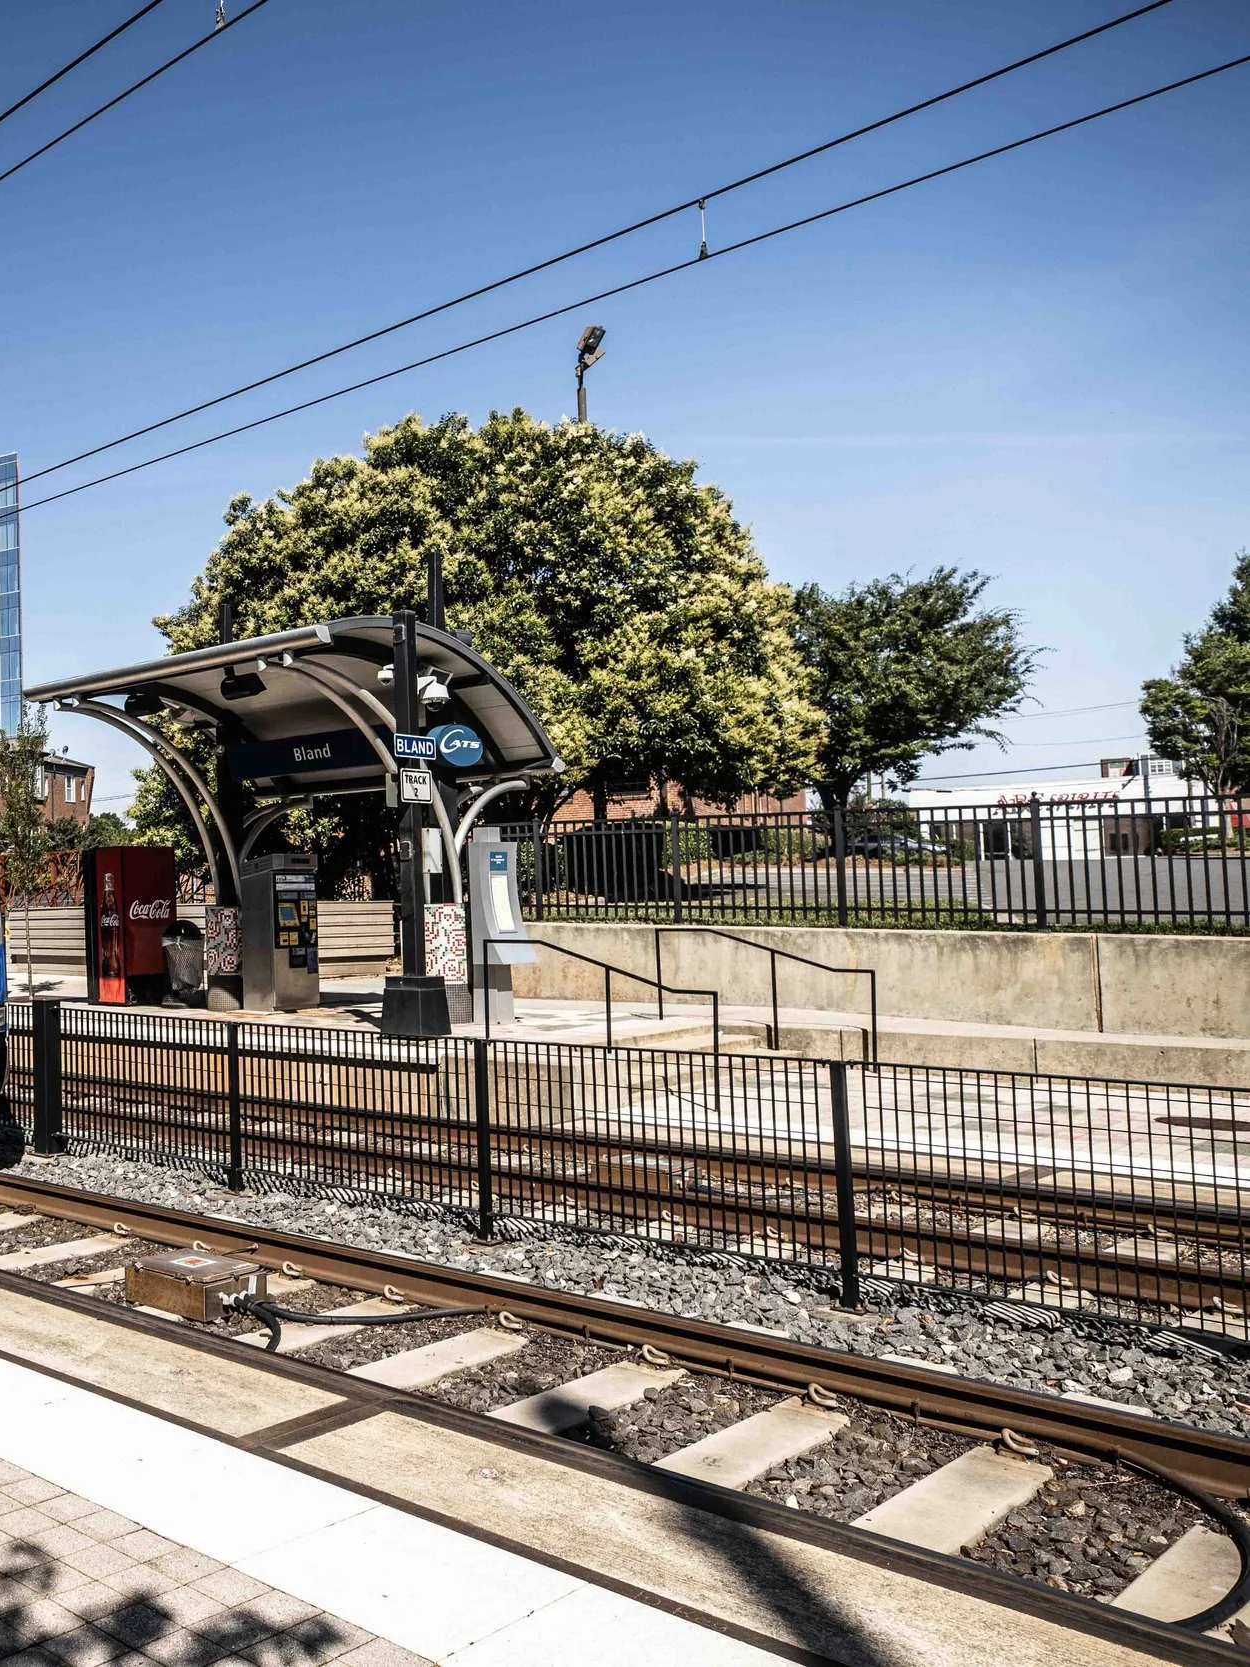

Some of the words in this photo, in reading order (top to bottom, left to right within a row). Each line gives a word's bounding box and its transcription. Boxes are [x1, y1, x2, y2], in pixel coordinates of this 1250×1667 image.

[396, 738, 434, 755] BLAND
[440, 729, 481, 753] CATS
[293, 743, 331, 761] Bland
[404, 774, 427, 785] TRACK
[414, 787, 419, 797] 2
[129, 899, 171, 920] Coca-Cola
